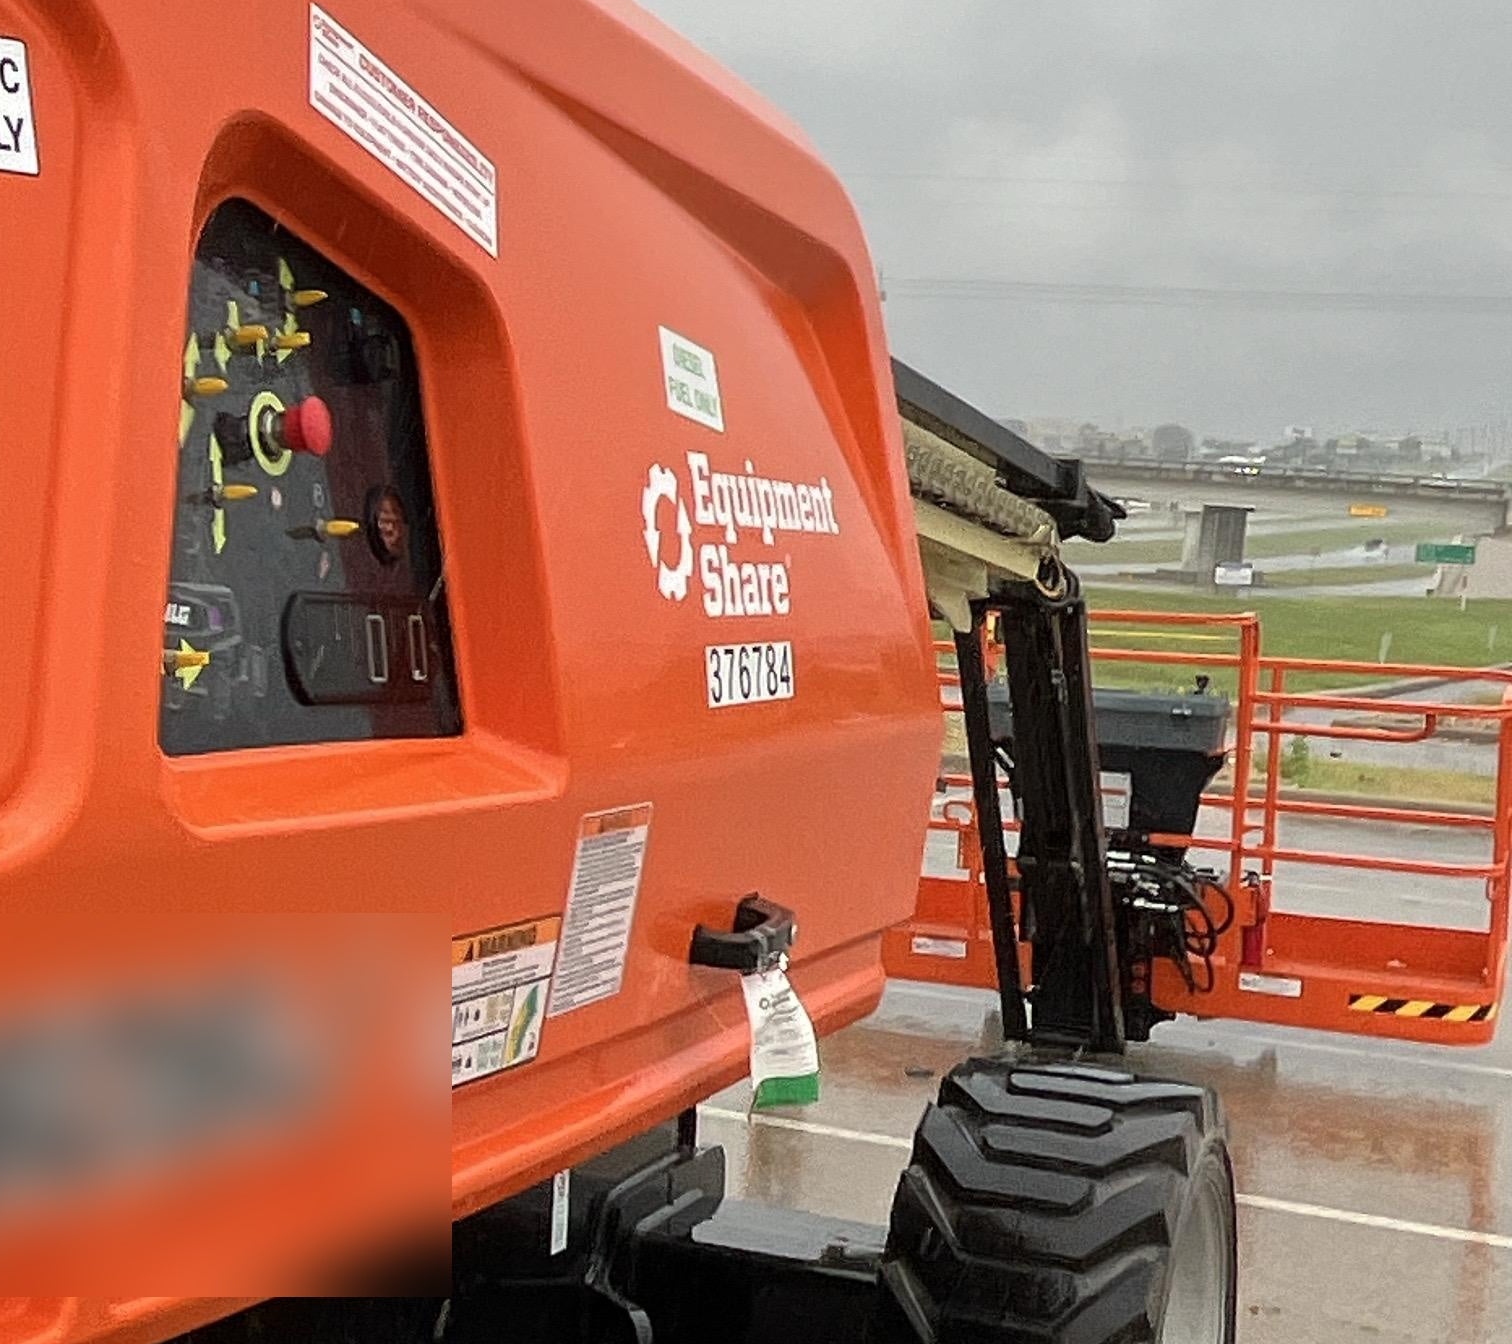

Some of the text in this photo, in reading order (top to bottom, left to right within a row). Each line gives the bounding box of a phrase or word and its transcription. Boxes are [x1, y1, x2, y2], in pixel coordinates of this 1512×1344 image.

[686, 450, 840, 546] Equipment
[699, 544, 791, 618] Share
[709, 645, 792, 704] 376784
